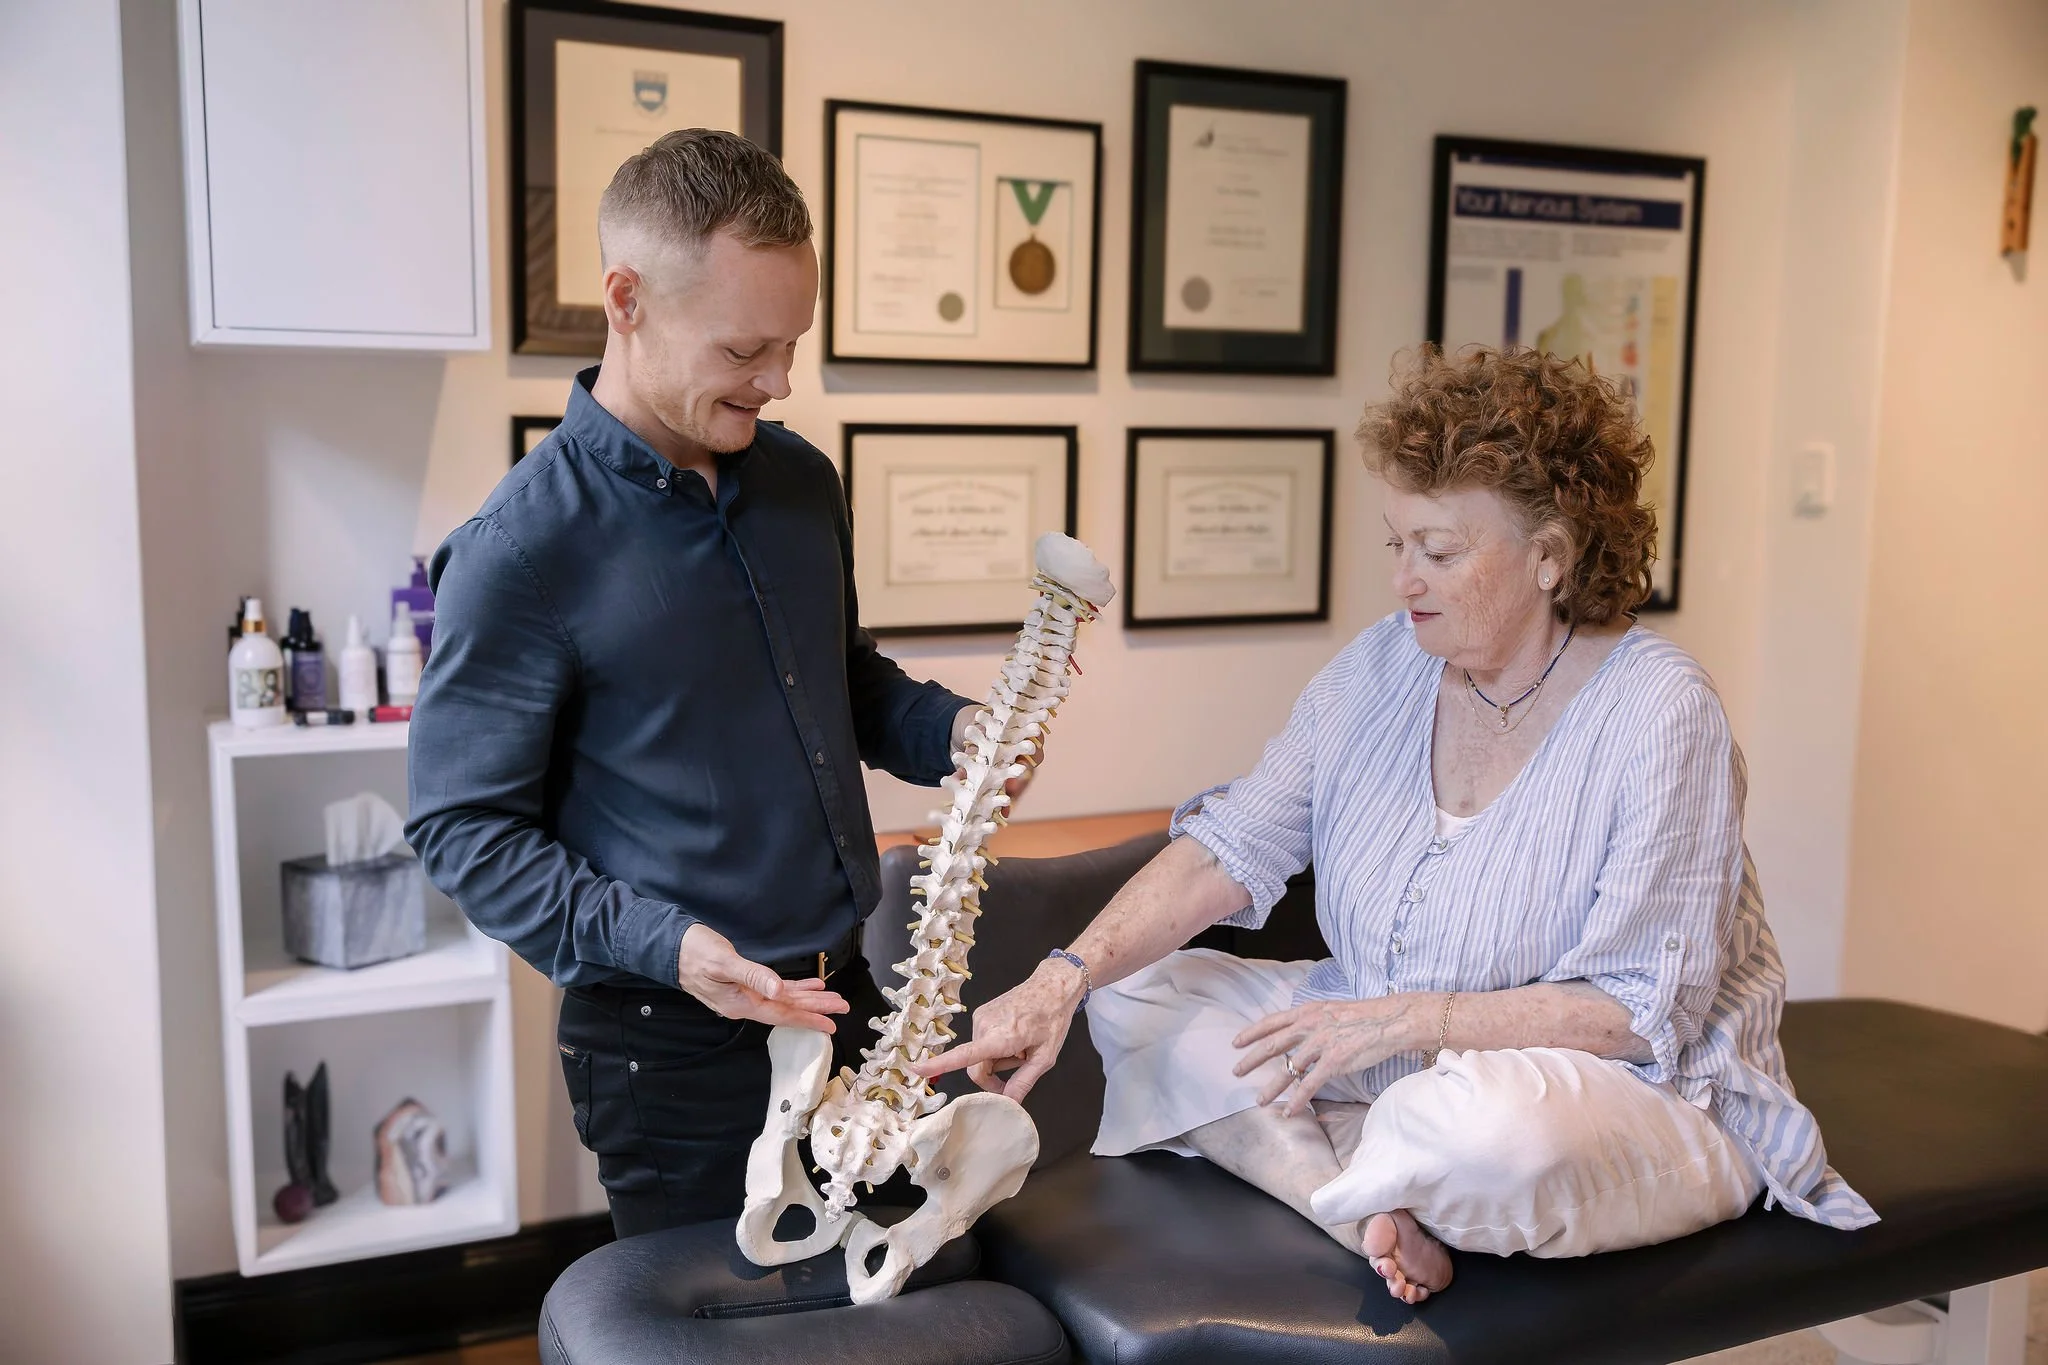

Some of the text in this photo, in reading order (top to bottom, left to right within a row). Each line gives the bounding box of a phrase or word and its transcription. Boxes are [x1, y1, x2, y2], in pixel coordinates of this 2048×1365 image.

[1457, 189, 1643, 224] Your Nervous System
